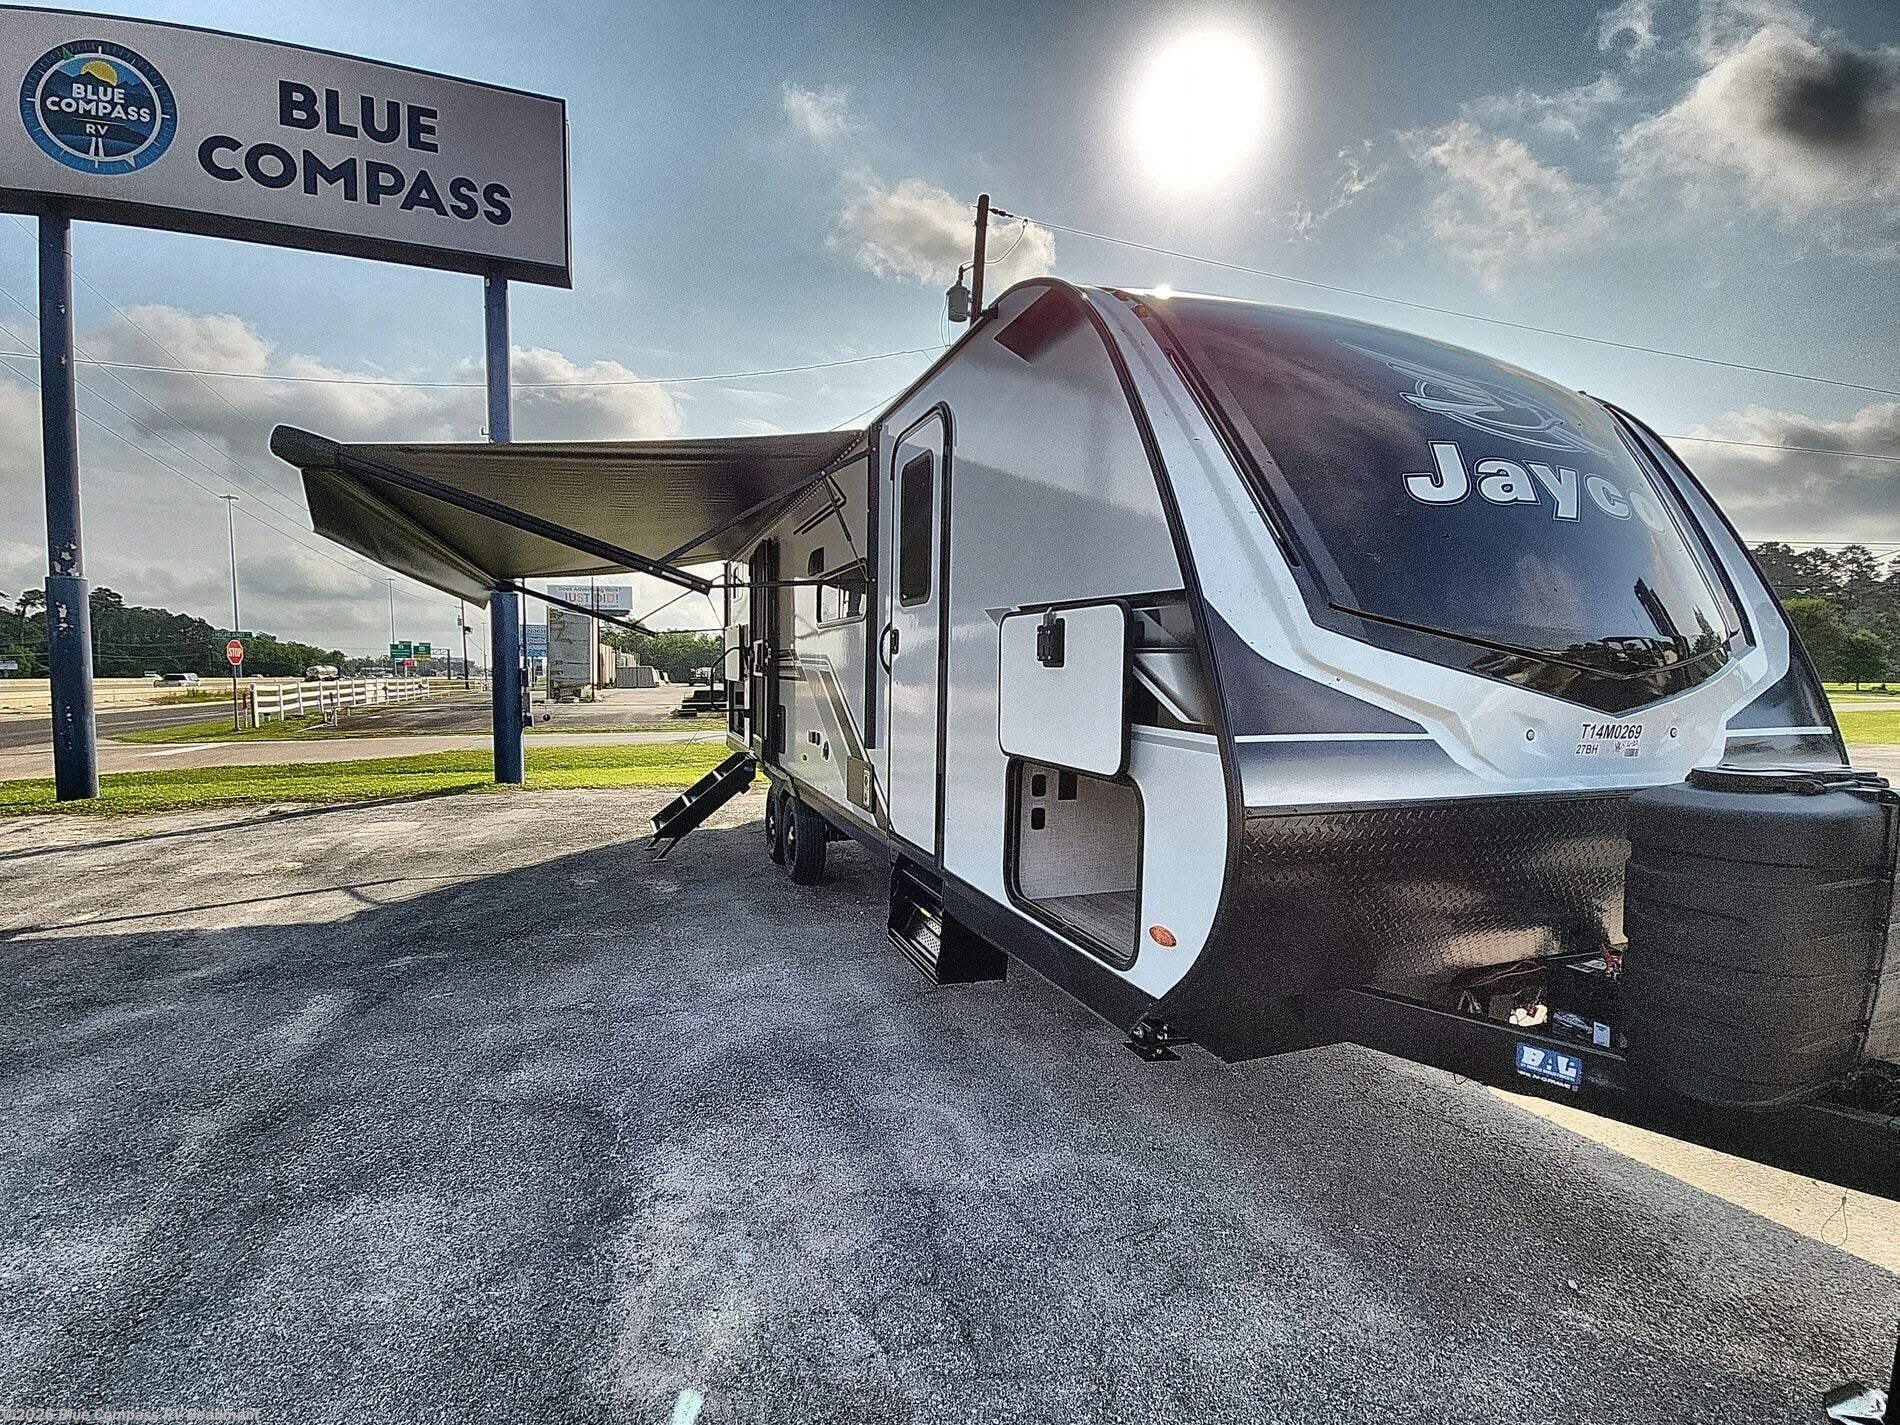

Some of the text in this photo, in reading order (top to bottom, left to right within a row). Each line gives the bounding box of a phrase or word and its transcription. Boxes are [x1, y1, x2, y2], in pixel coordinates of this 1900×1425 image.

[71, 82, 126, 104] BLUE
[45, 96, 152, 123] COMPASS
[278, 79, 440, 154] BLUE
[85, 123, 109, 136] RV
[197, 134, 513, 227] COMPASS
[1402, 440, 1667, 533] Jayco
[228, 647, 242, 657] STOP
[1581, 723, 1643, 740] T14M0269
[1575, 744, 1599, 755] 27BH
